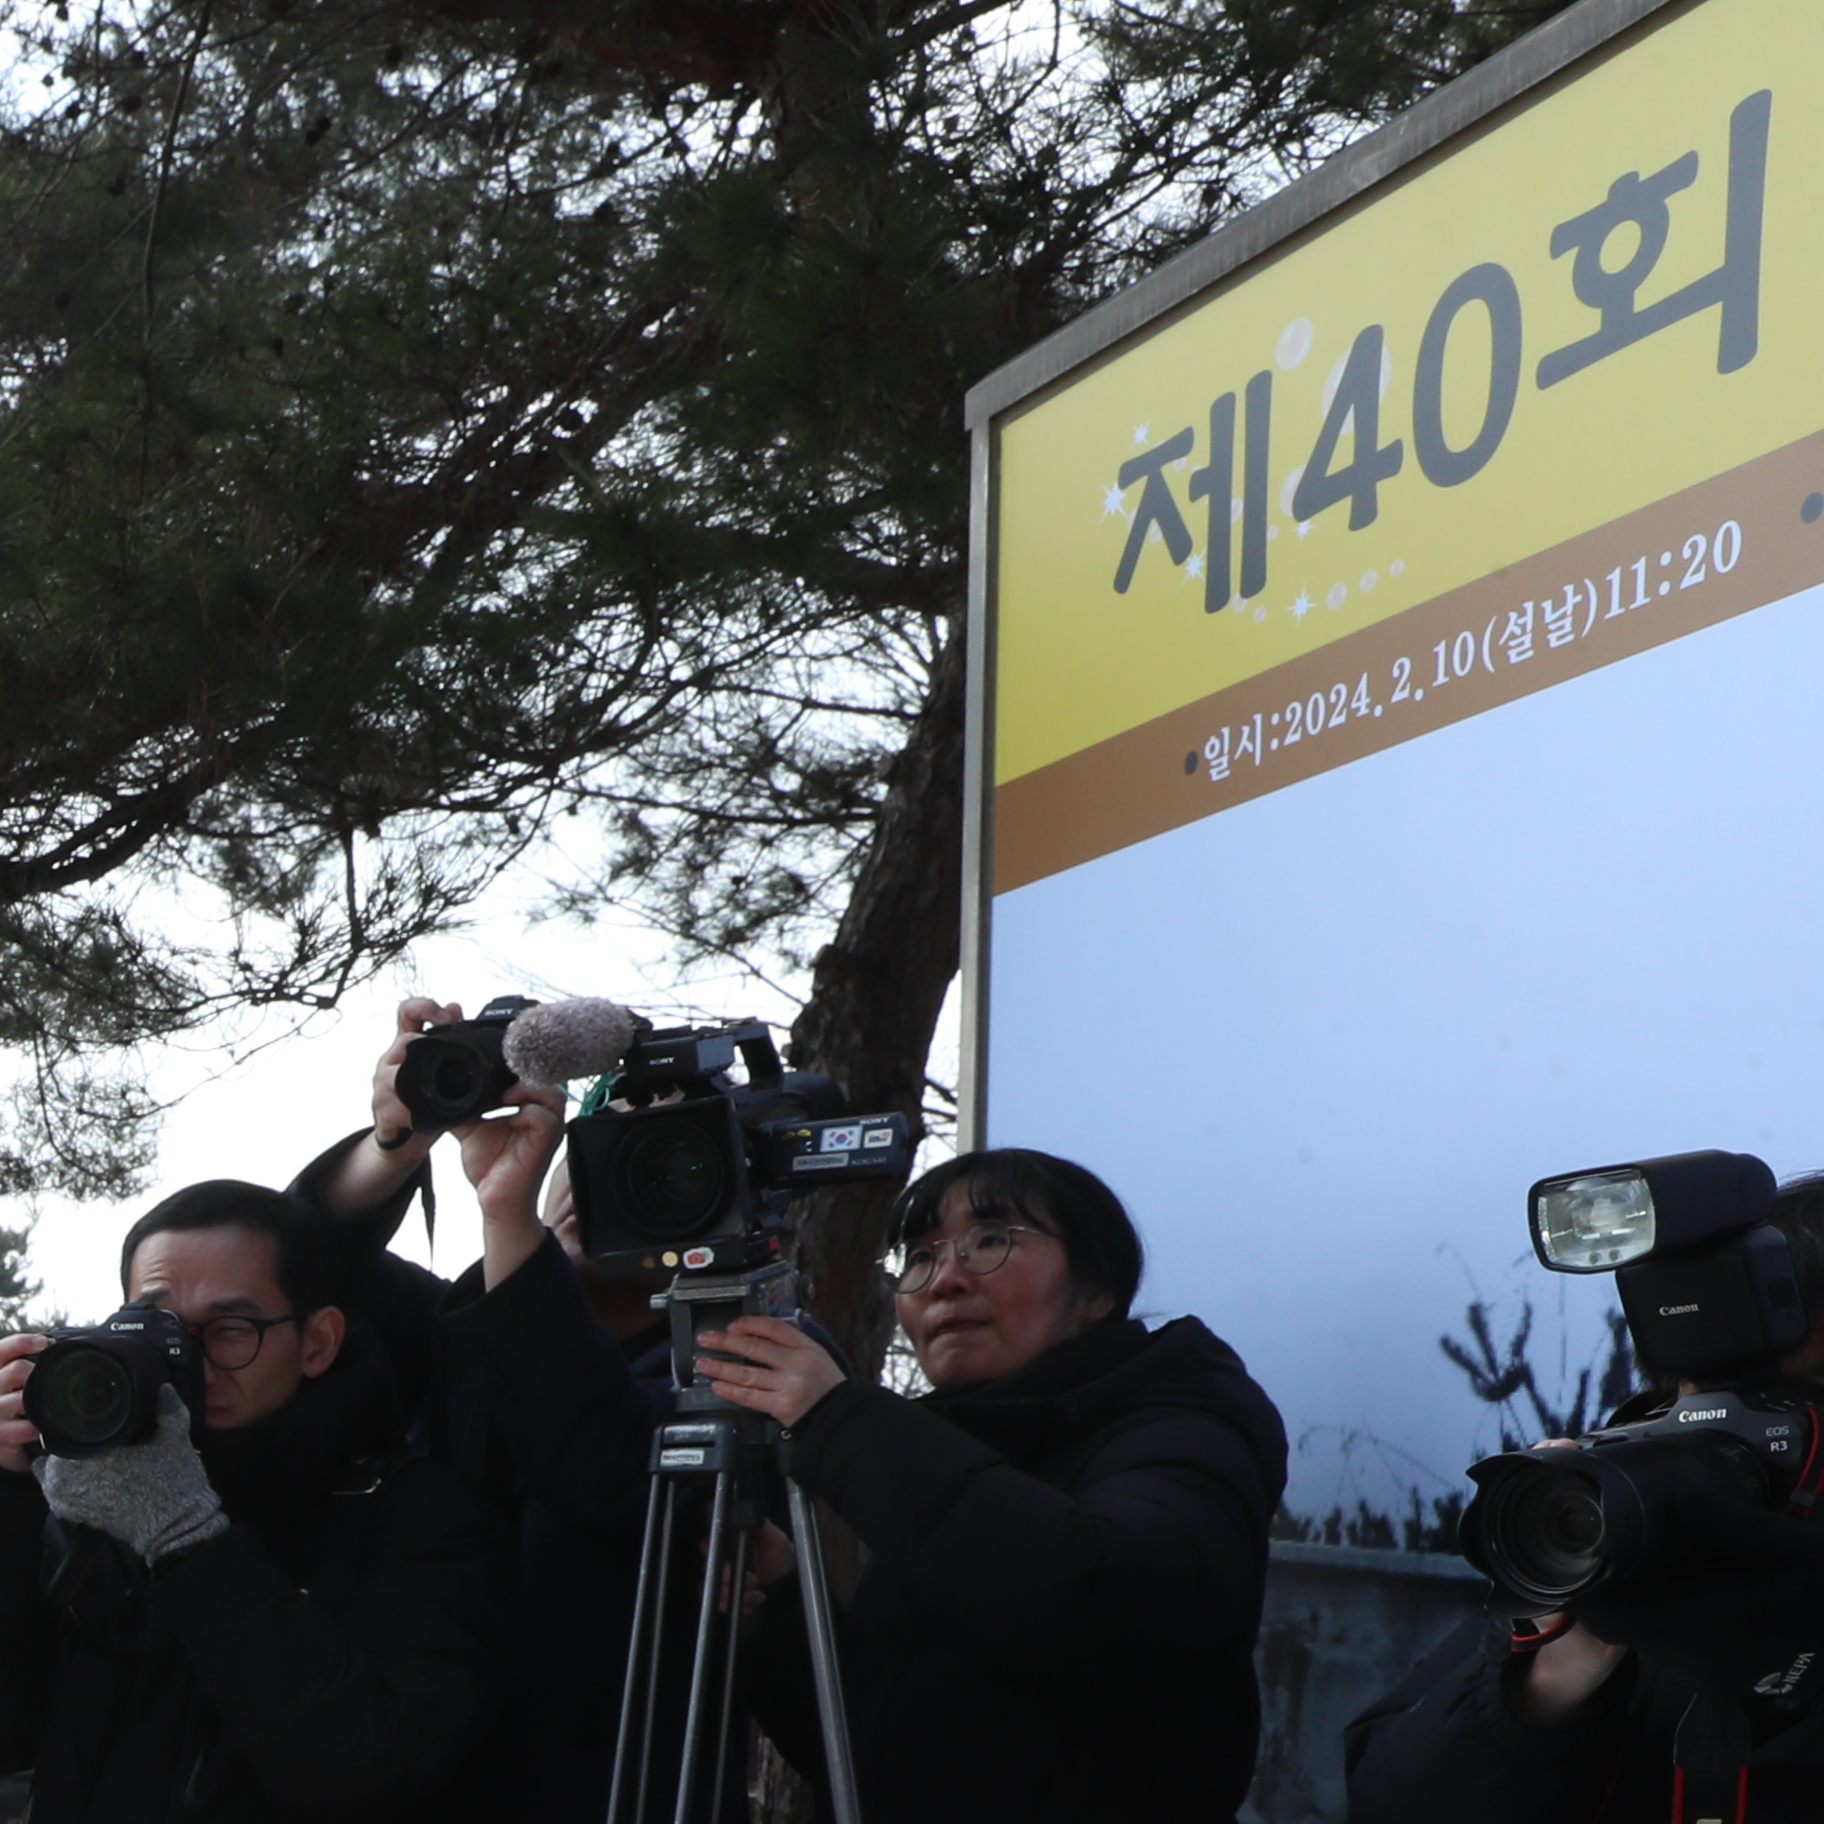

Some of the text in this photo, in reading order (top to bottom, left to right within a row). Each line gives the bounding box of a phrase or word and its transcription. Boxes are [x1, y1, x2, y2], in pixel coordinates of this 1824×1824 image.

[1113, 88, 1773, 614] 제40회
[484, 1008, 514, 1017] SONY
[649, 1057, 675, 1066] SONY
[859, 1116, 890, 1125] SONY
[1659, 1303, 1700, 1316] Canon
[110, 1322, 145, 1331] Canon
[168, 1347, 181, 1355] R3
[1678, 1408, 1728, 1423] Canon
[1765, 1425, 1790, 1437] EOS
[1770, 1440, 1789, 1453] R3
